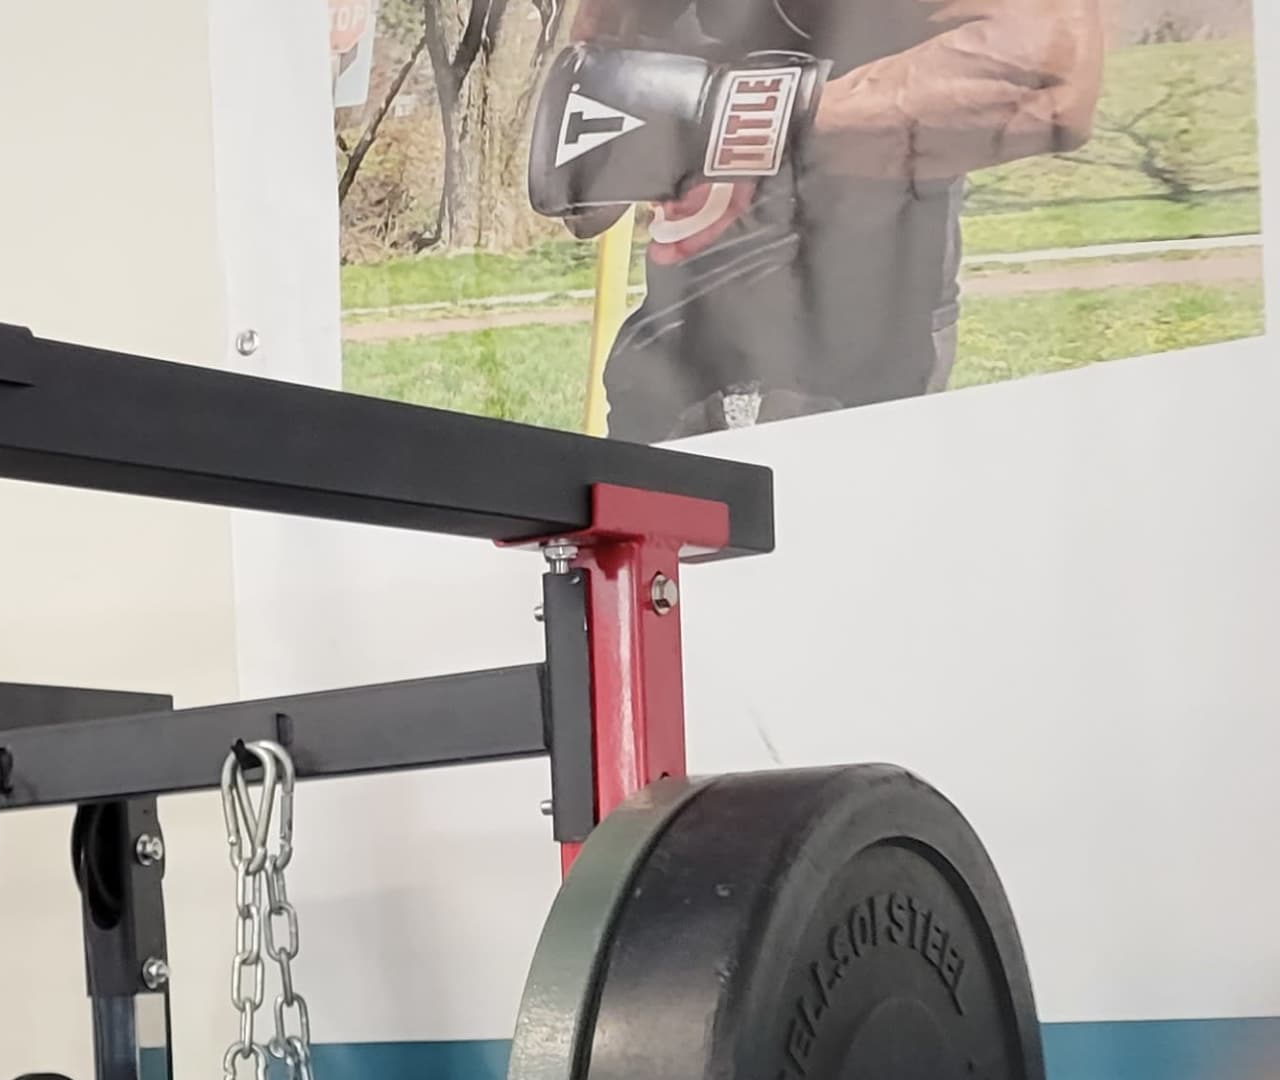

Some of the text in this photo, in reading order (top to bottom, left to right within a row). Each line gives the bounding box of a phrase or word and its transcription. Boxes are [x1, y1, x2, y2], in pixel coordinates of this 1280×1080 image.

[565, 111, 624, 145] T
[718, 78, 782, 165] TITLE
[887, 892, 965, 1016] STEEL
